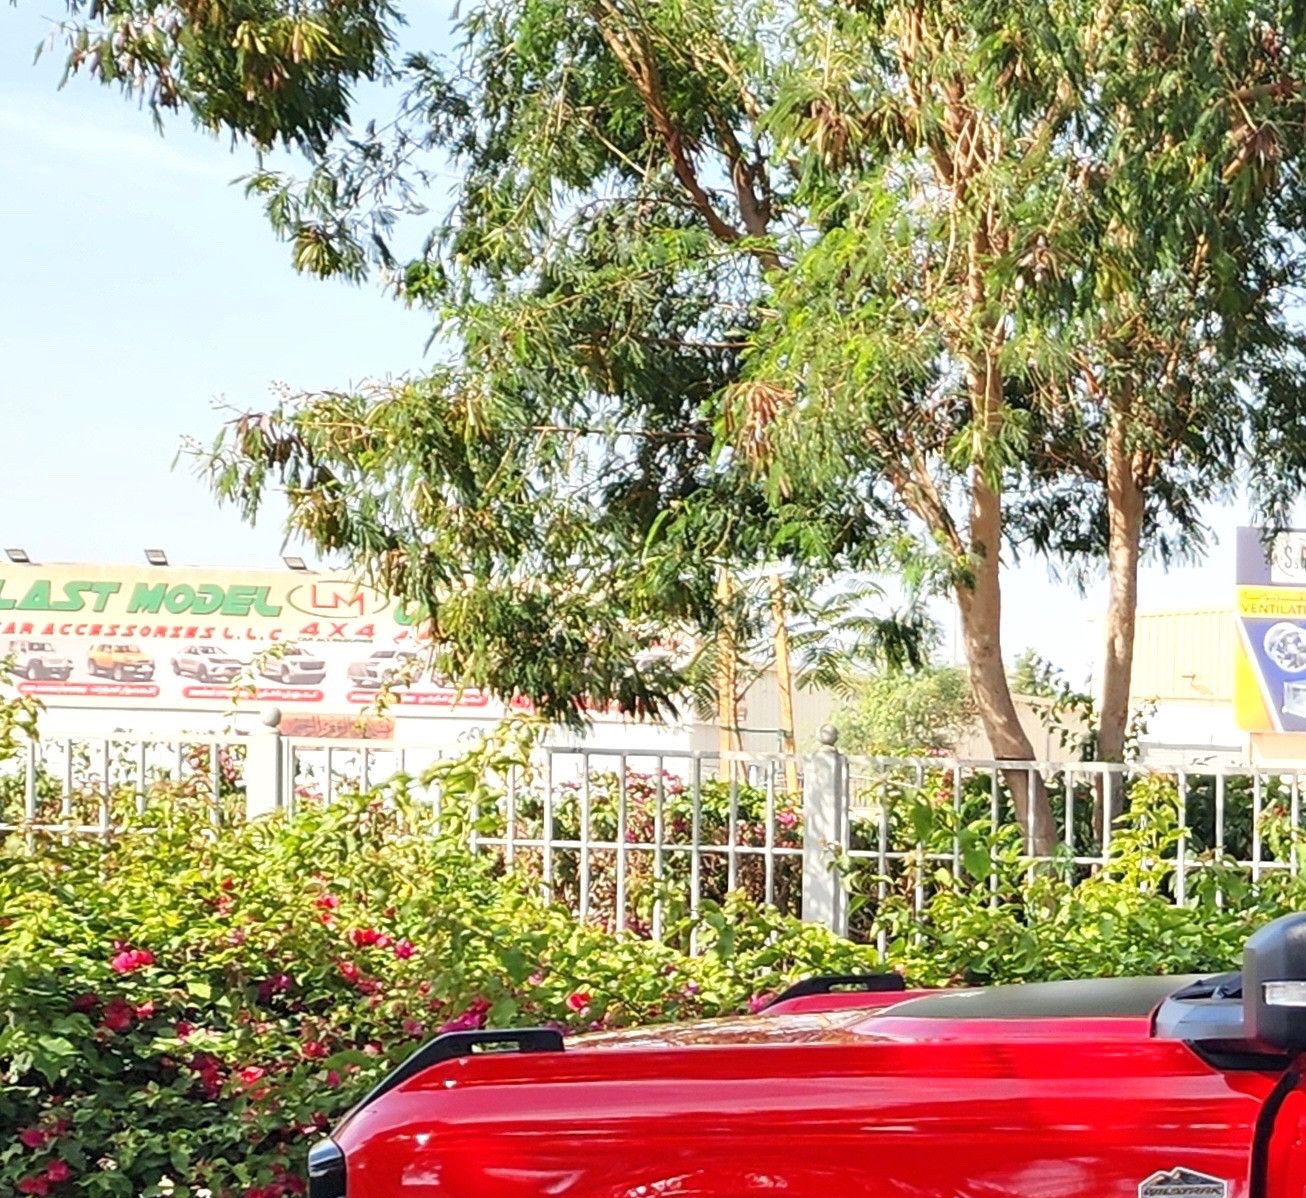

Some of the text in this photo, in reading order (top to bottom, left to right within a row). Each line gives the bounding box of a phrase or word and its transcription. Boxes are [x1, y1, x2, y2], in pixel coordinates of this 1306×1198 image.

[0, 579, 283, 618] LAST MODEL
[0, 621, 283, 641] AR ACCESSORIES L.L.C
